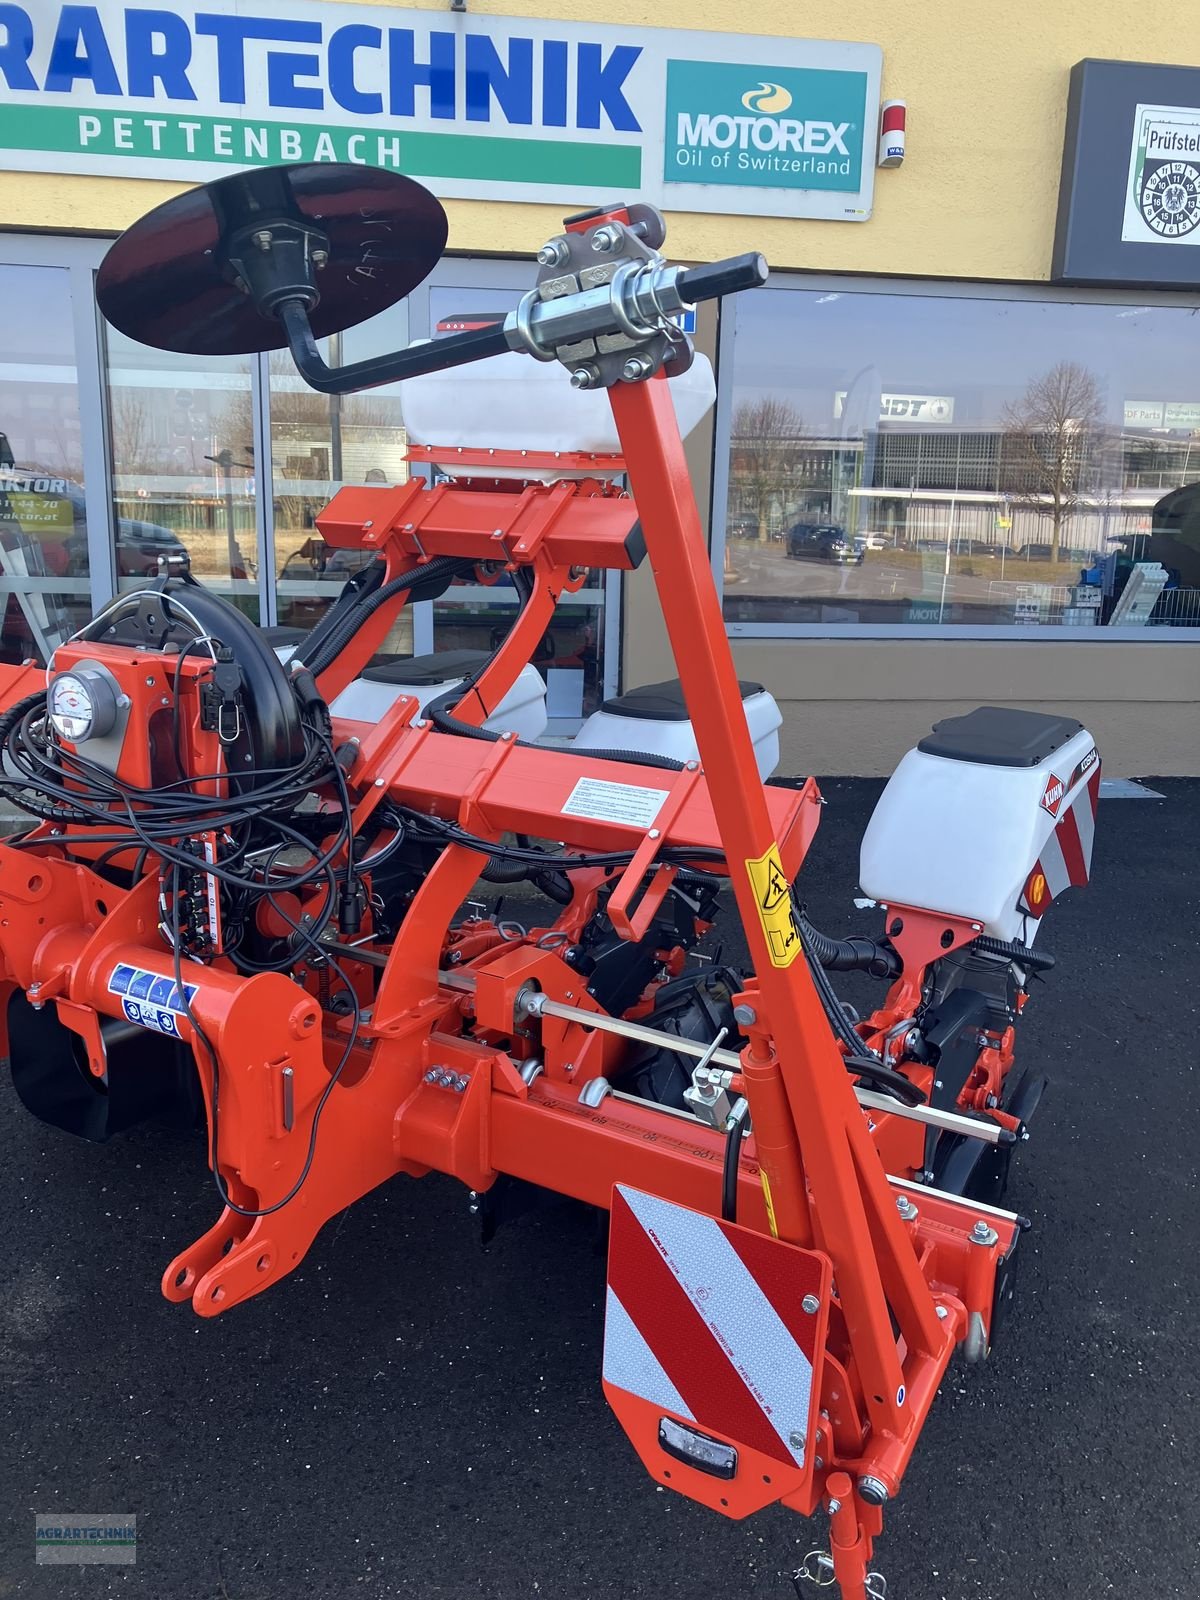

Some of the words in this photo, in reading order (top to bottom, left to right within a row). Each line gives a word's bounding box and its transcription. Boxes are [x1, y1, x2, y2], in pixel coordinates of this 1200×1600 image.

[79, 115, 401, 167] PETTENBACH
[677, 112, 850, 156] MOTOREX
[676, 149, 702, 166] Oil
[711, 152, 729, 168] of
[738, 152, 850, 175] Switzerland
[1045, 782, 1063, 808] KUHN
[648, 1229, 669, 1258] ORALITE
